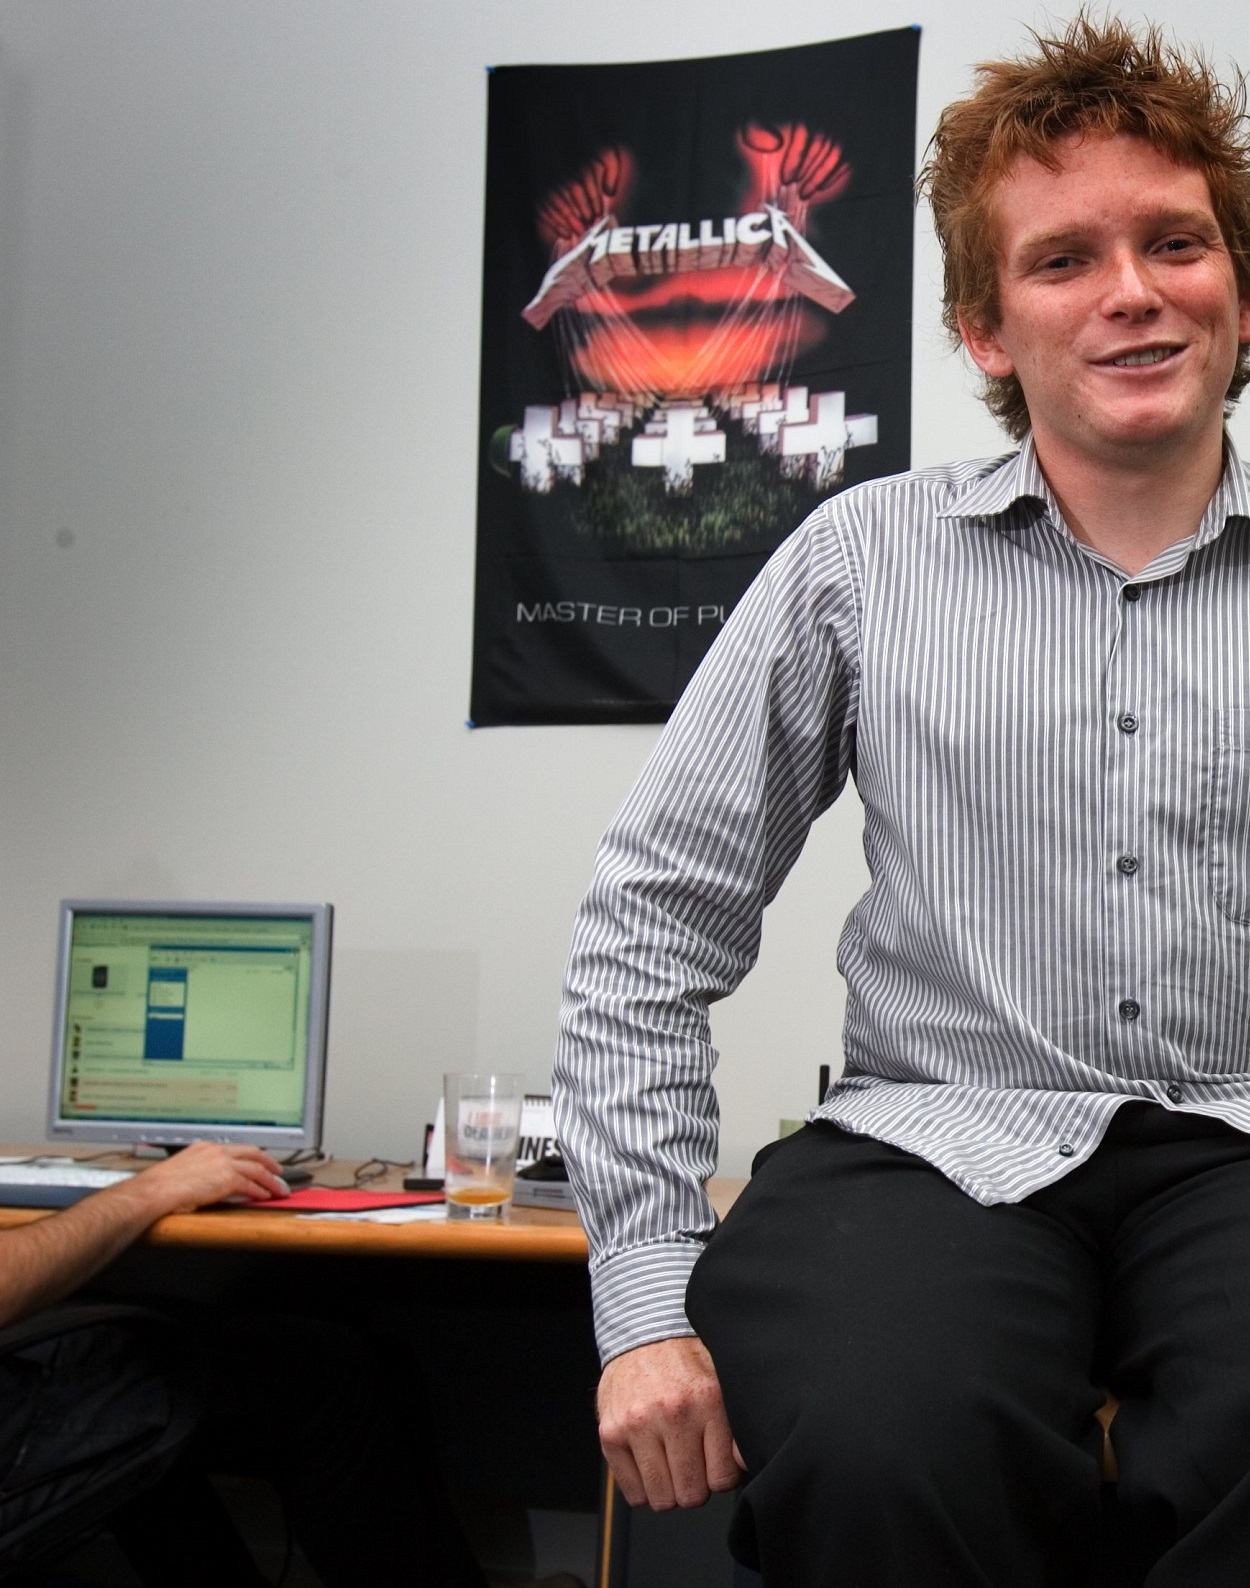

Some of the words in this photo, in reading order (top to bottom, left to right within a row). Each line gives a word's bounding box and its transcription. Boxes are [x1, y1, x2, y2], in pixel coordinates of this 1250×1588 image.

[524, 203, 854, 318] METALLICA
[516, 601, 642, 627] MASTER
[649, 606, 690, 627] OF
